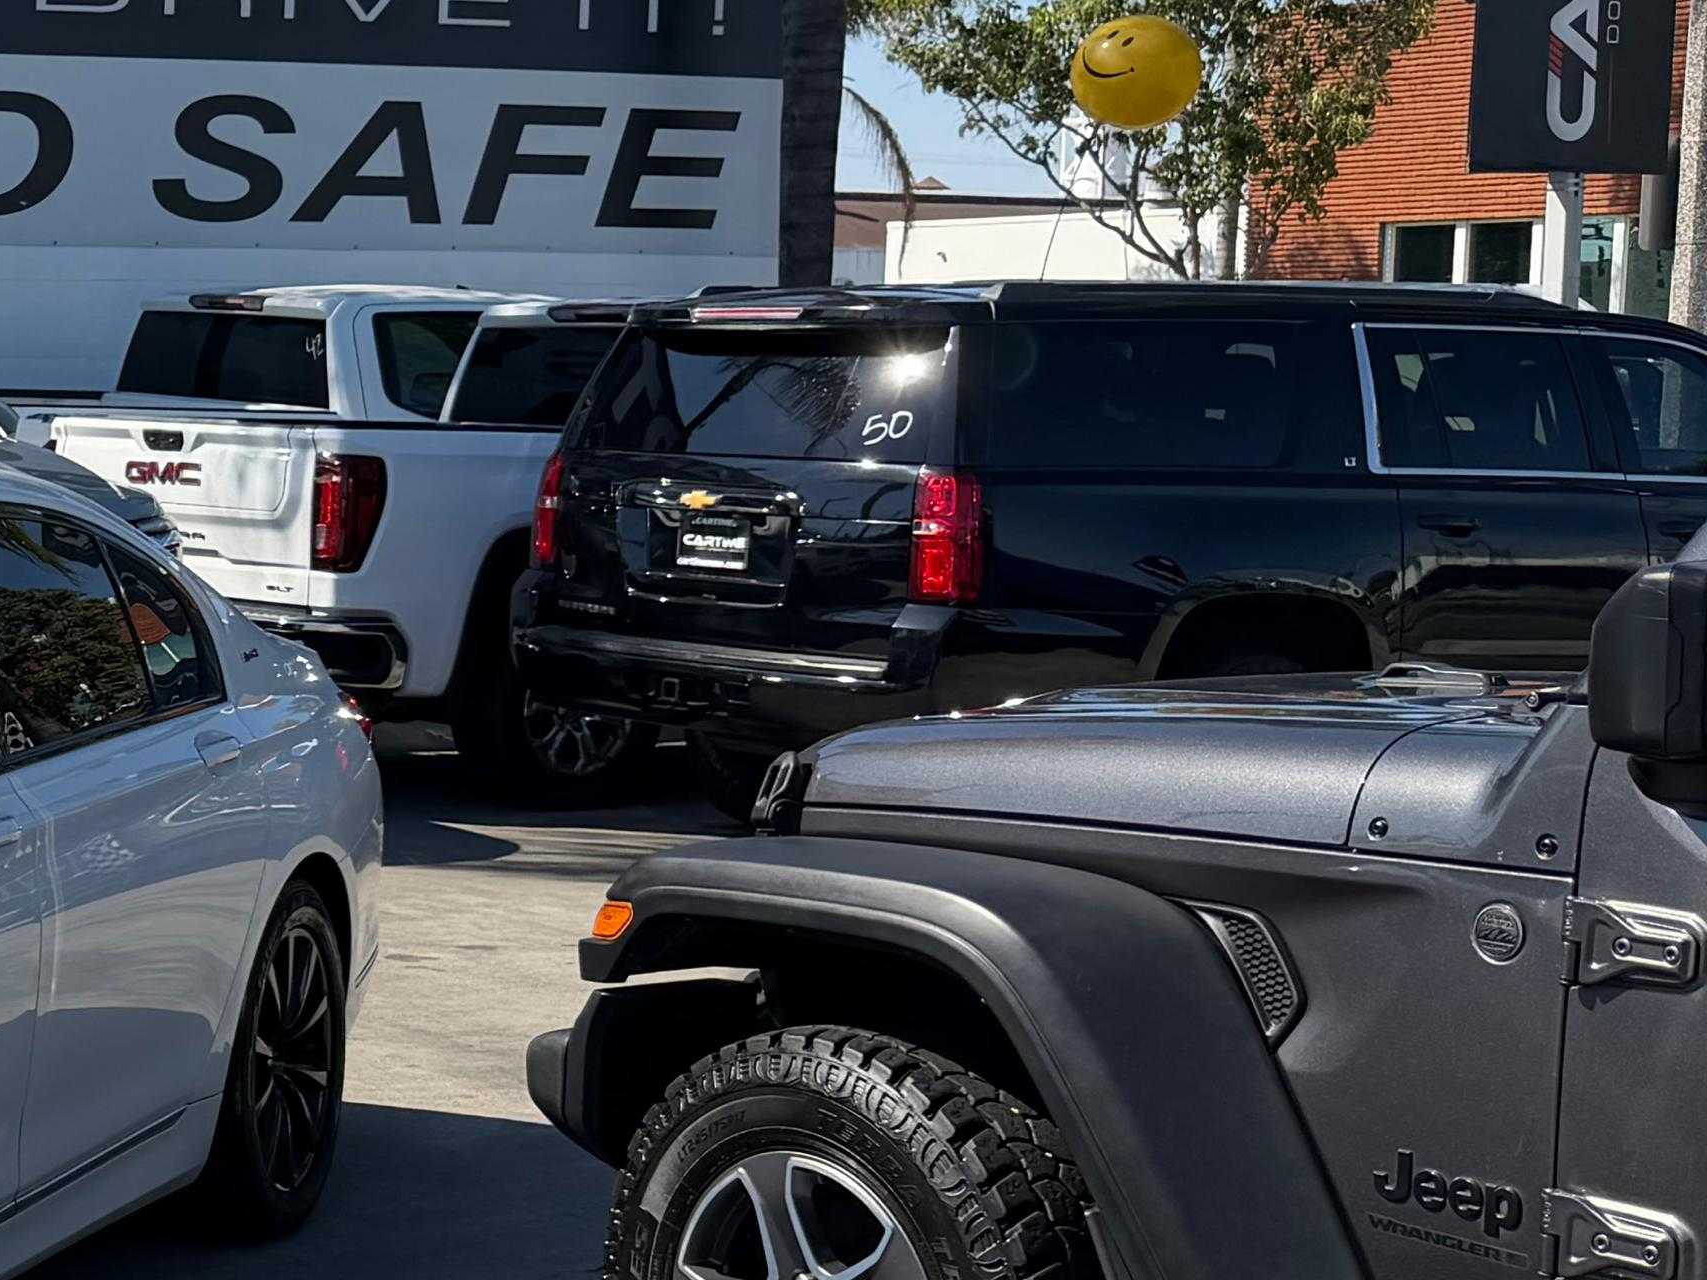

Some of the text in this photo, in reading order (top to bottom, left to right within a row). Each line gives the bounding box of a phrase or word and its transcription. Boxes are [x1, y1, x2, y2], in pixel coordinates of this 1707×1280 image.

[151, 93, 745, 230] SAFE
[861, 410, 914, 446] 50
[125, 460, 202, 487] GMC
[682, 533, 748, 549] CARTIME
[1372, 1148, 1525, 1239] Jeep
[1366, 1213, 1507, 1262] WRANGLER
